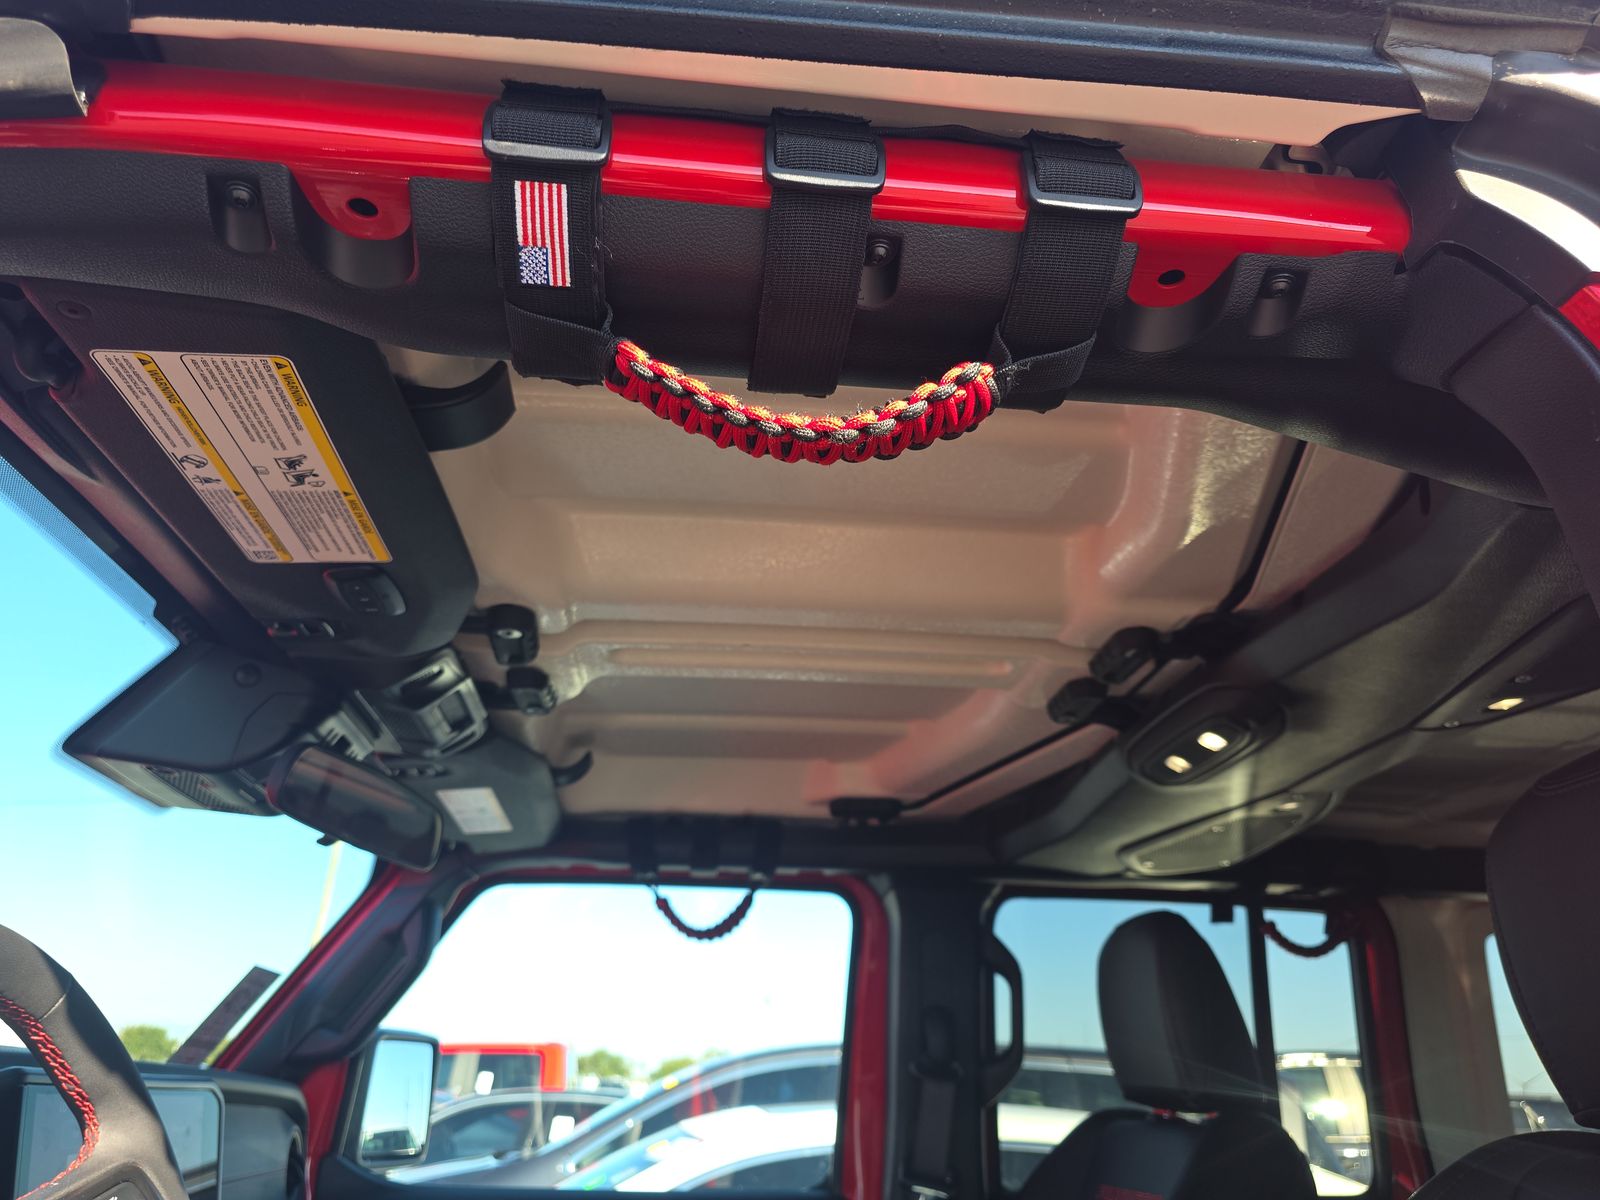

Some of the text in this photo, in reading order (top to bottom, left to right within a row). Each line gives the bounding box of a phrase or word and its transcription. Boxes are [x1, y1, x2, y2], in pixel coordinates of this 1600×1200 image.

[146, 369, 181, 404] WARNING
[259, 359, 273, 372] EVEN
[267, 374, 280, 386] WITH
[280, 373, 308, 406] WARNING
